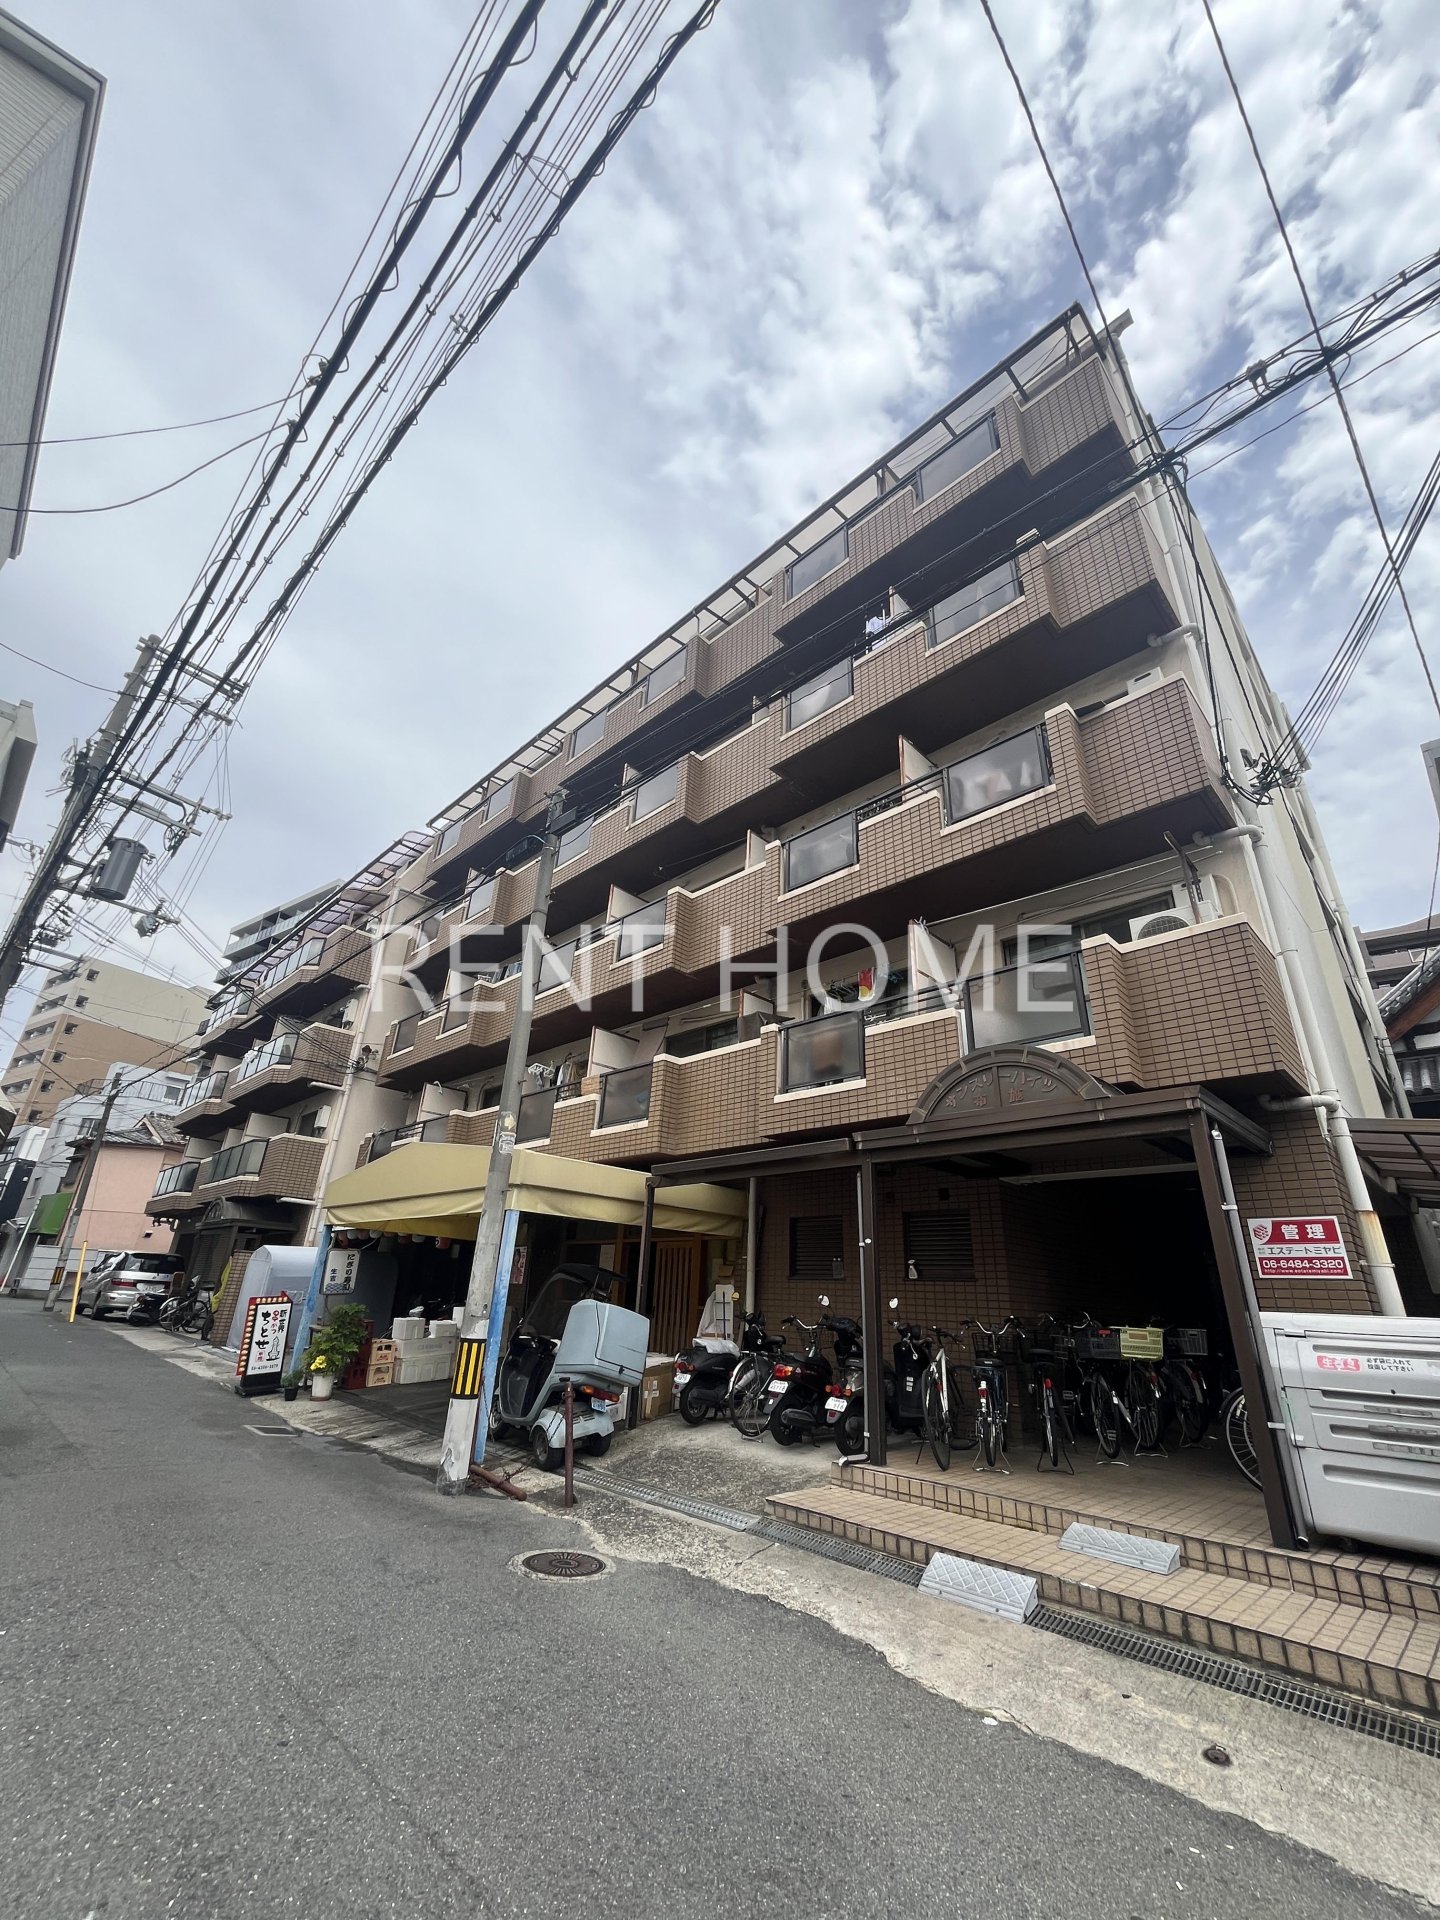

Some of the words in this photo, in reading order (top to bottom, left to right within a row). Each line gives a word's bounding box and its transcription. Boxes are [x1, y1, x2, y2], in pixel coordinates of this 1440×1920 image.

[1281, 1224, 1326, 1240] 管理
[1267, 1246, 1342, 1255] エステートミヤビ
[1262, 1259, 1344, 1268] 06-6484-3320
[255, 1310, 272, 1349] ちとせ
[270, 1310, 280, 1335] 串かつ
